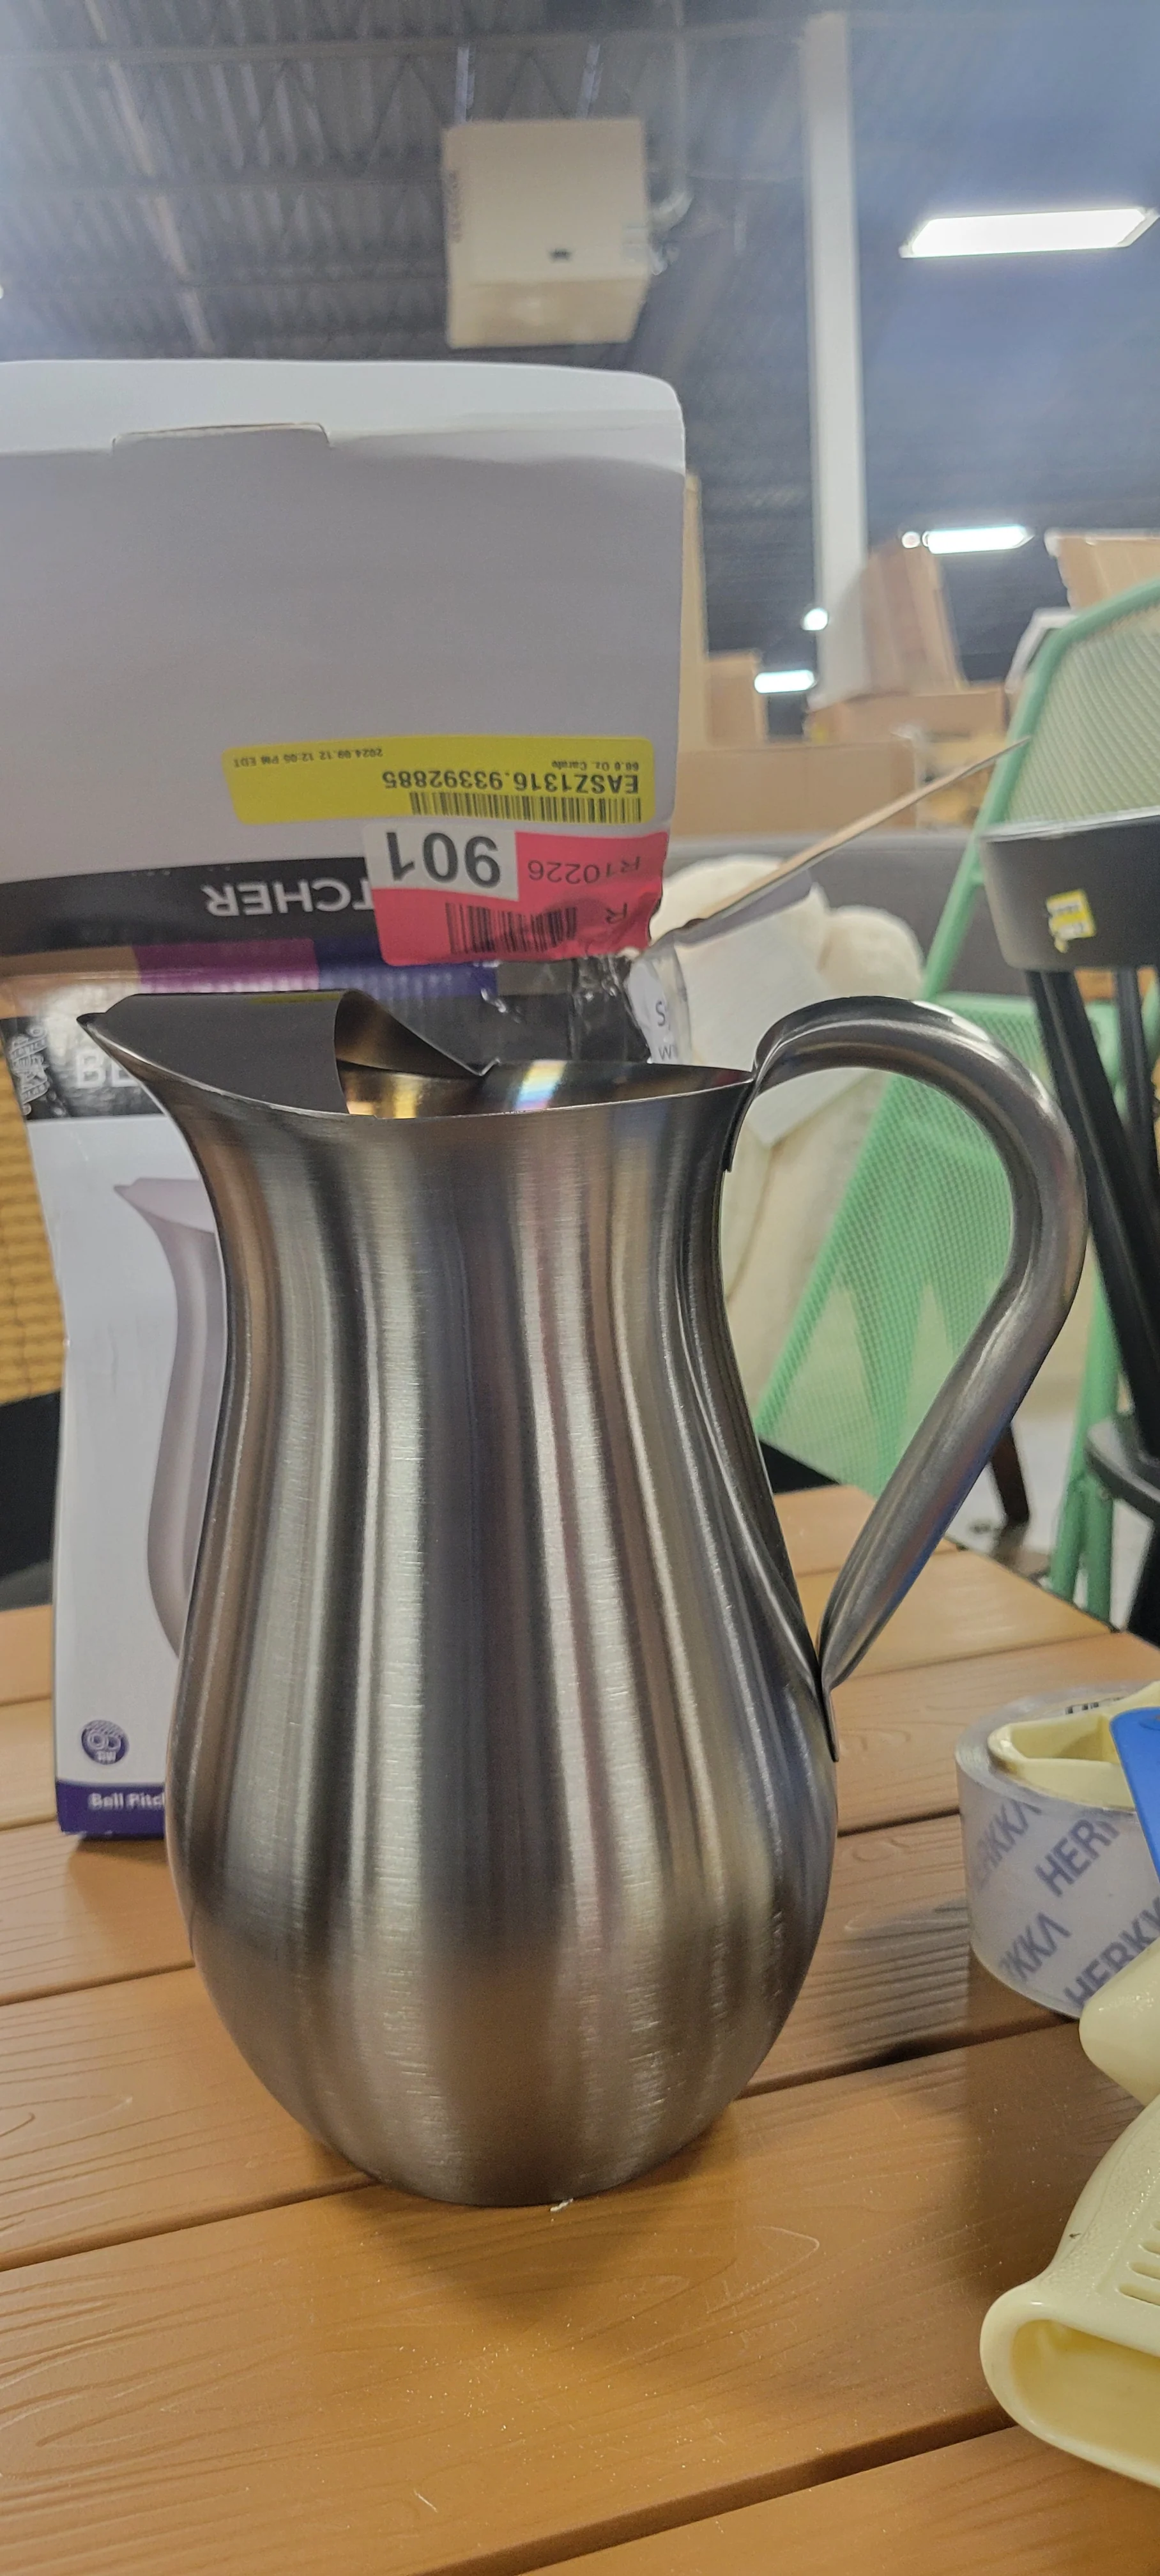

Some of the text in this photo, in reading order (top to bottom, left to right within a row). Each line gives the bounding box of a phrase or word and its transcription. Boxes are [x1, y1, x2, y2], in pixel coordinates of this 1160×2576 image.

[234, 757, 257, 768] EDT
[383, 770, 639, 794] EASZ1316.93392885
[385, 832, 501, 889] 901
